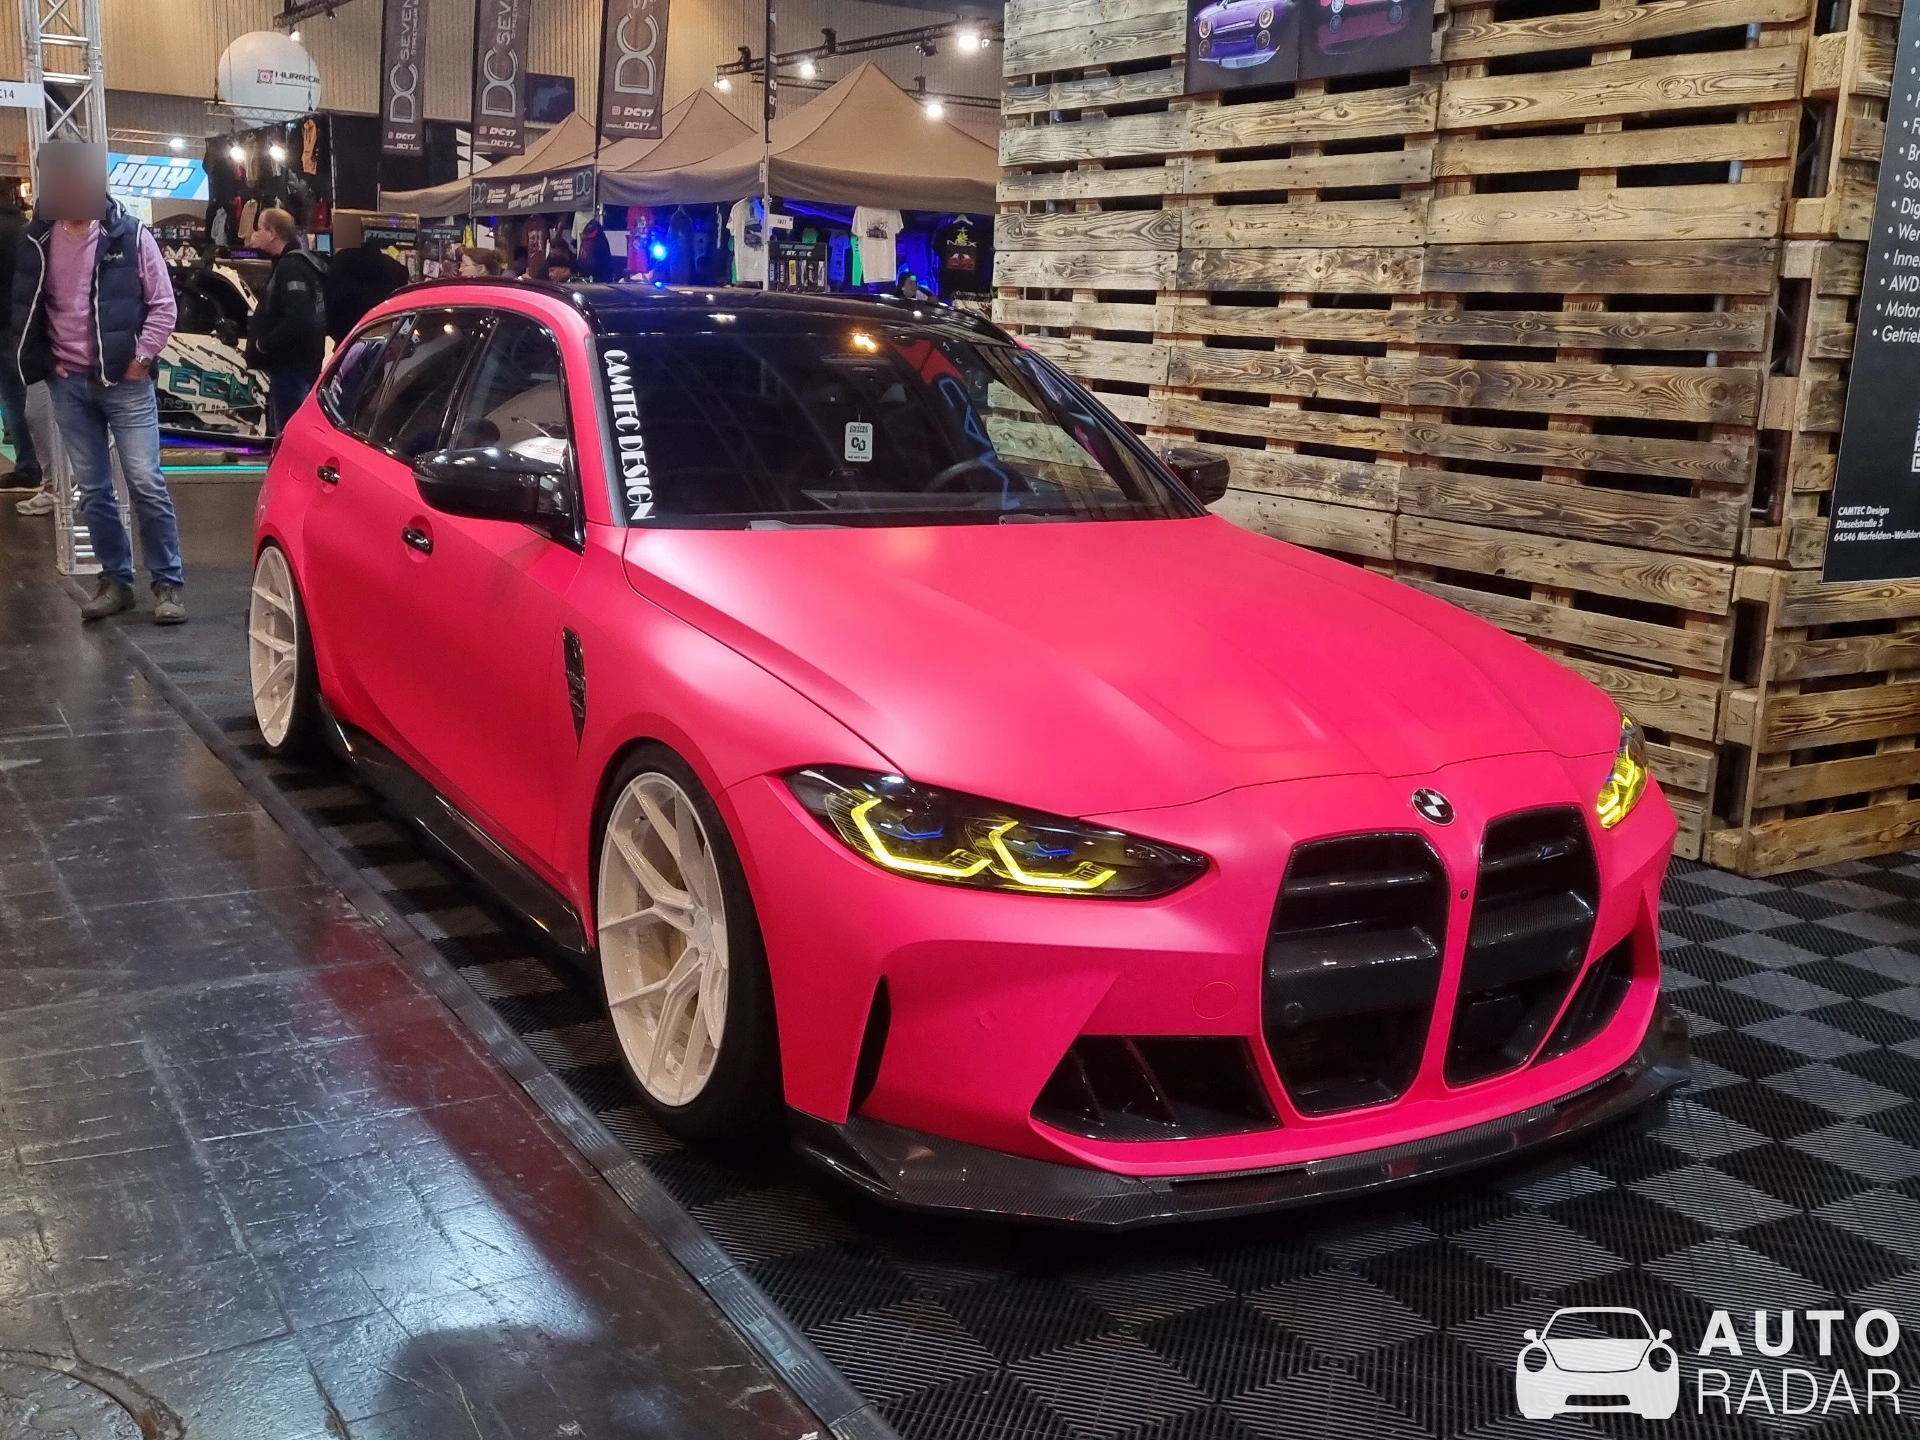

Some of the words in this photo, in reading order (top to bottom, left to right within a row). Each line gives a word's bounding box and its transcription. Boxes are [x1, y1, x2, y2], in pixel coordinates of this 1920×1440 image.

[623, 107, 654, 117] DC17
[395, 132, 416, 140] DC17
[489, 127, 516, 137] DC17
[109, 162, 196, 190] HOLY
[1904, 170, 1920, 189] So
[1884, 300, 1920, 318] Motor
[604, 350, 641, 432] CAMTEC
[617, 435, 656, 521] DESIGN
[1838, 506, 1866, 516] CAMTEC
[1866, 505, 1890, 516] Design
[1836, 518, 1877, 528] Dieselstraße
[1877, 518, 1884, 527] 5
[1833, 532, 1856, 542] 64546
